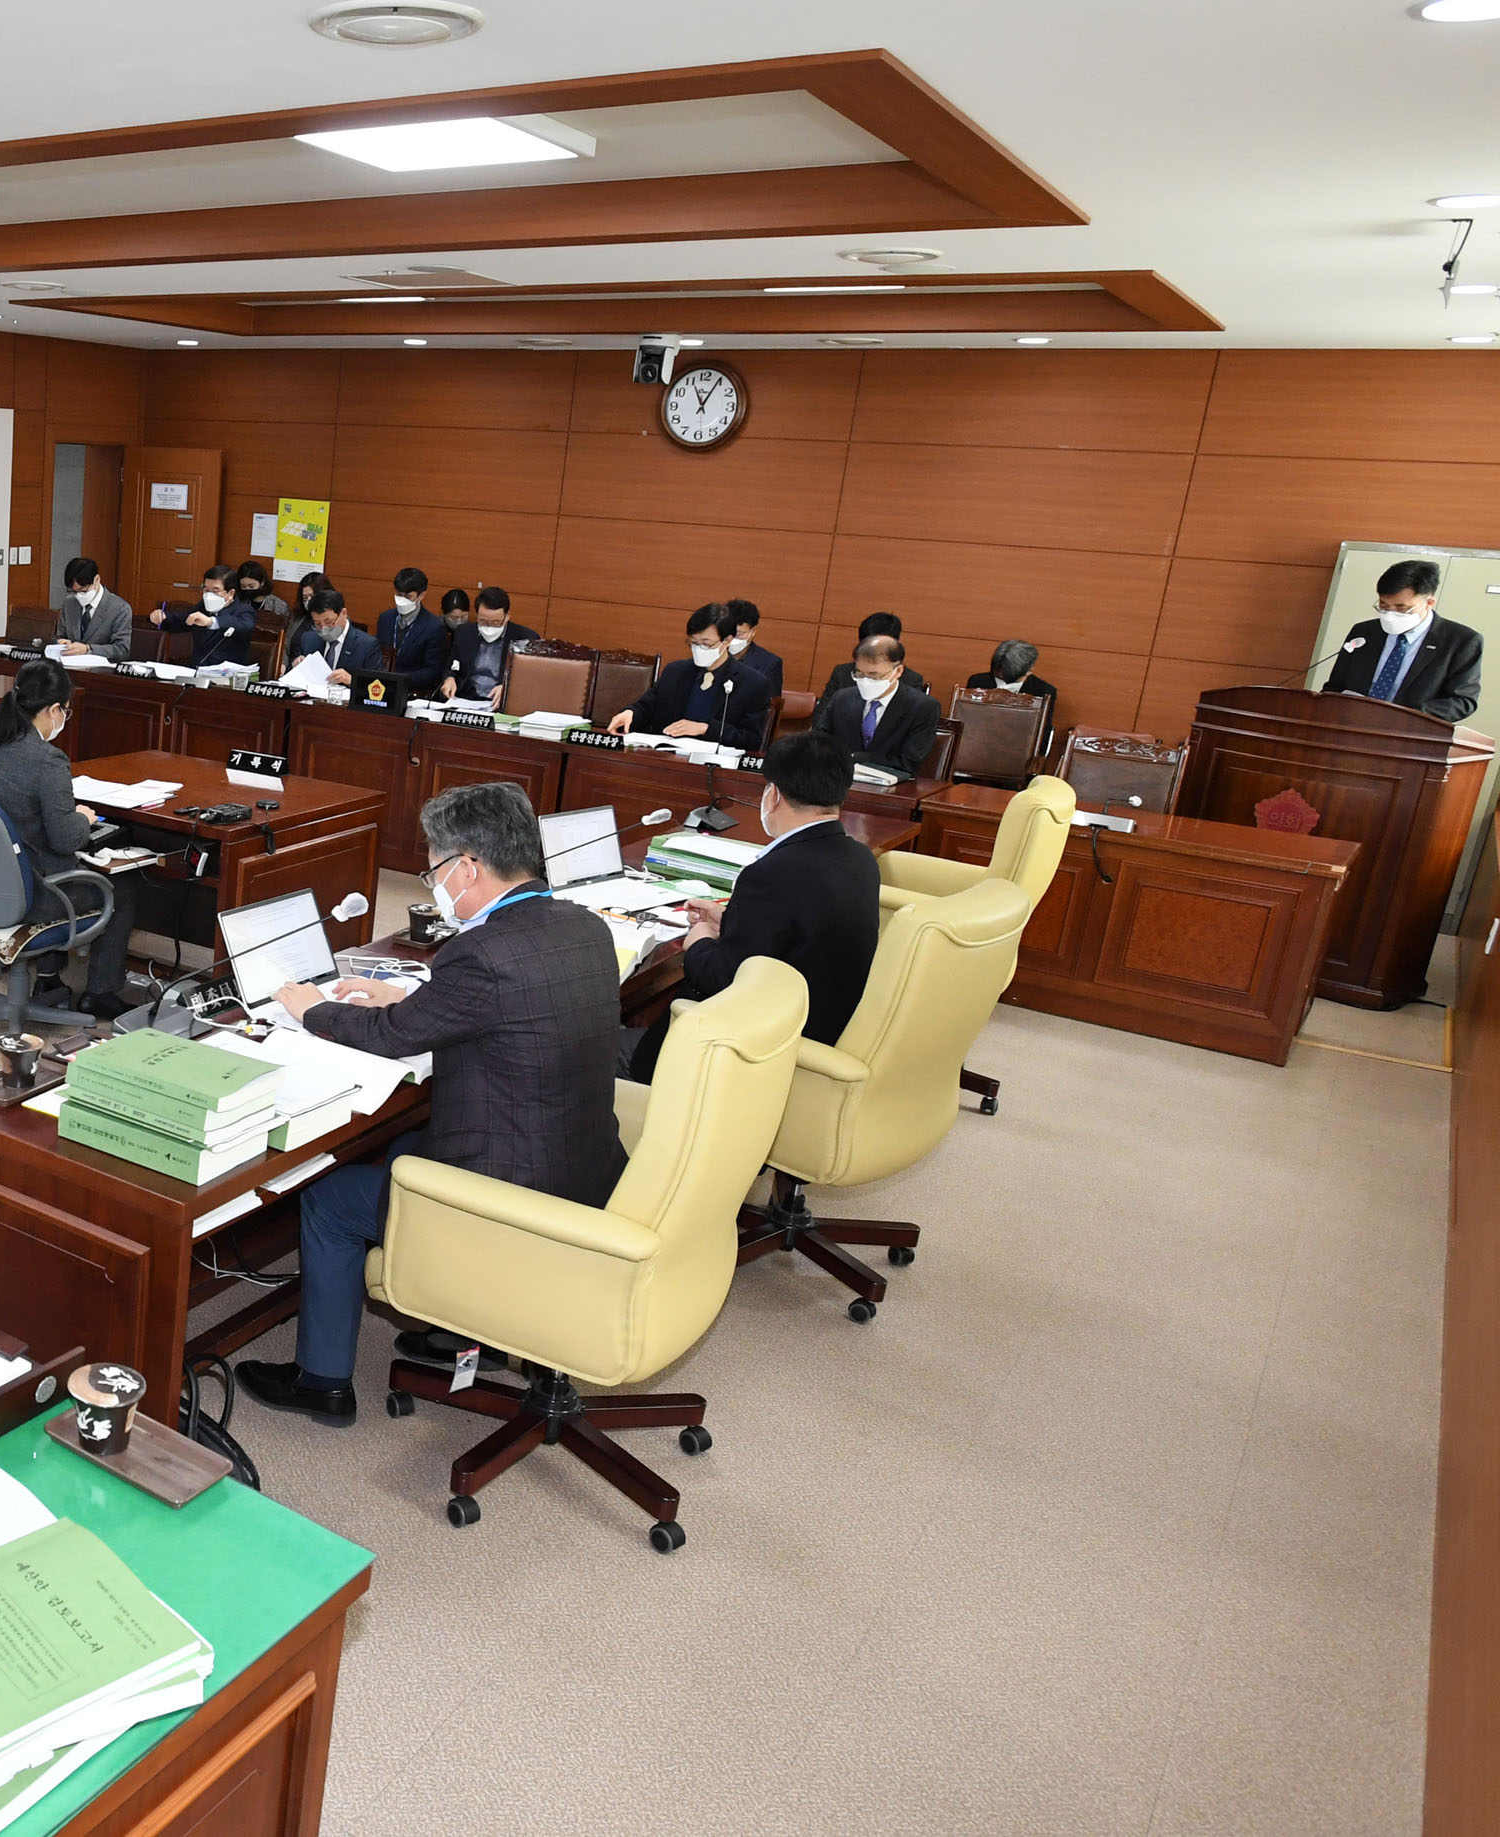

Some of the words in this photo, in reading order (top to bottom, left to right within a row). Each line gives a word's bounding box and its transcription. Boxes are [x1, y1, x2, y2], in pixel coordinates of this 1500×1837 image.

[685, 376, 696, 386] 11
[699, 371, 712, 382] 12
[675, 387, 686, 398] 10
[723, 388, 734, 398] 2
[669, 401, 679, 411] 9
[725, 402, 736, 412] 3
[670, 415, 681, 424] 8
[719, 415, 728, 425] 4
[680, 426, 690, 436] 7
[693, 430, 703, 440] 6
[708, 427, 718, 437] 5
[445, 711, 491, 727] 문화관광체육국장
[570, 731, 619, 748] 관광진흥과장
[230, 752, 283, 773] 기록석
[47, 1596, 104, 1654] 검토보고서
